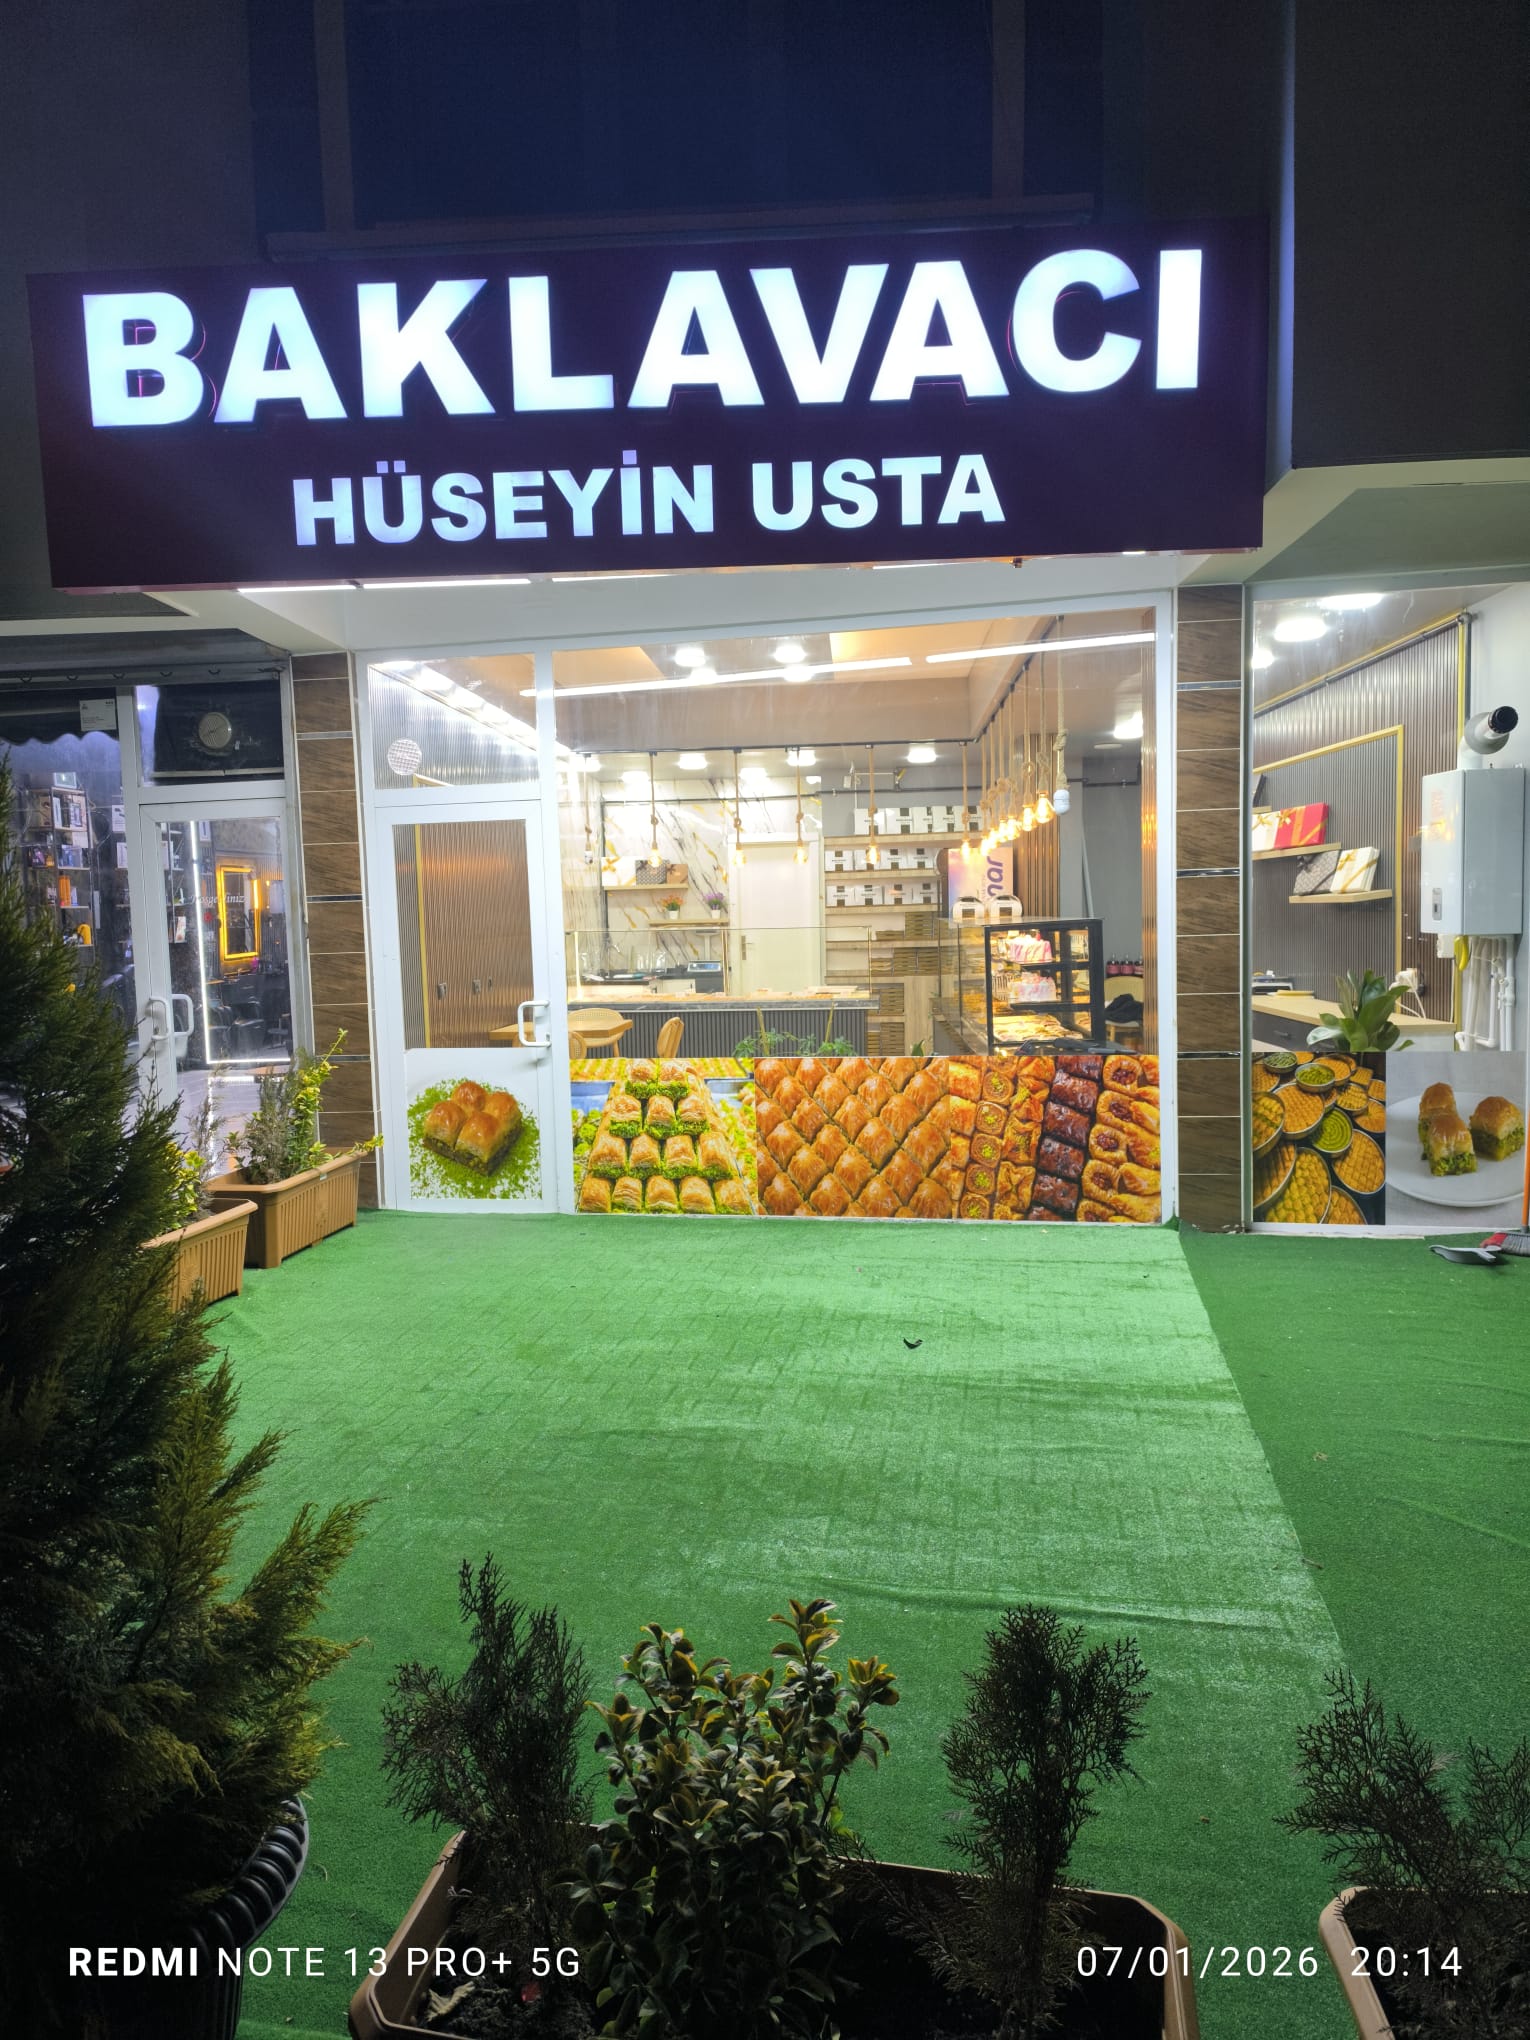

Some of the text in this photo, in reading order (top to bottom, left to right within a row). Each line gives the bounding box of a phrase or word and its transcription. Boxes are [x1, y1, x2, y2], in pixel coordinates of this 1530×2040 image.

[82, 248, 1203, 427] BAKLAVACI
[292, 449, 1006, 546] HÜSEYİN USTA
